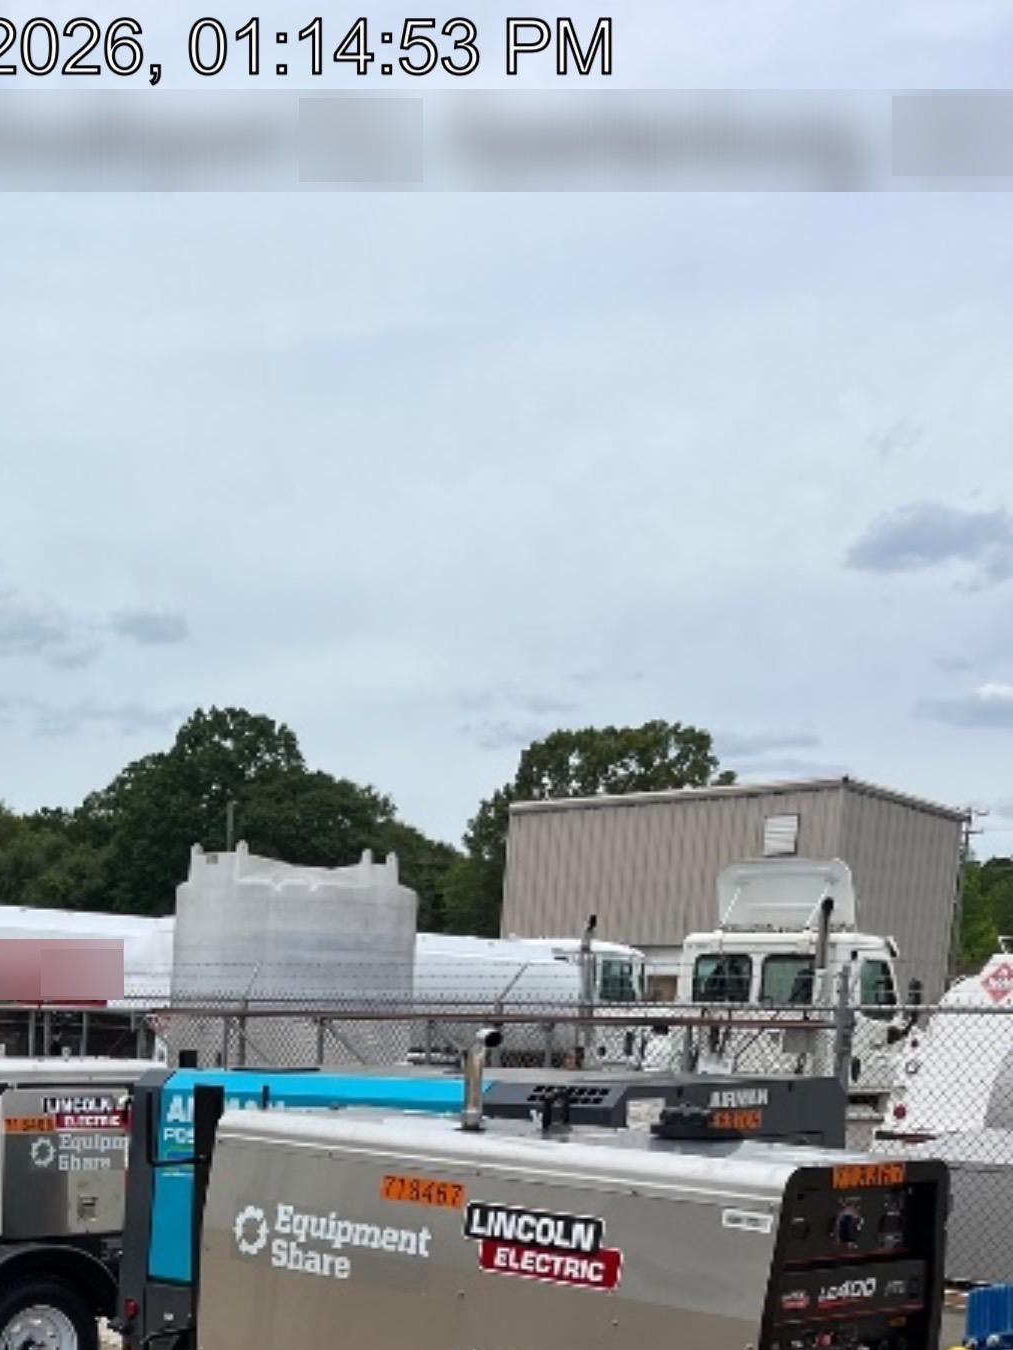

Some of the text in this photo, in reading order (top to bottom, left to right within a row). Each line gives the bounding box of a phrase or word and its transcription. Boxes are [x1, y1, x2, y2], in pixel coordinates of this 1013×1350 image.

[274, 1203, 432, 1258] Equipment
[470, 1206, 596, 1252] LINCOLN
[271, 1239, 351, 1280] Share
[493, 1246, 606, 1283] ELECTRIC
